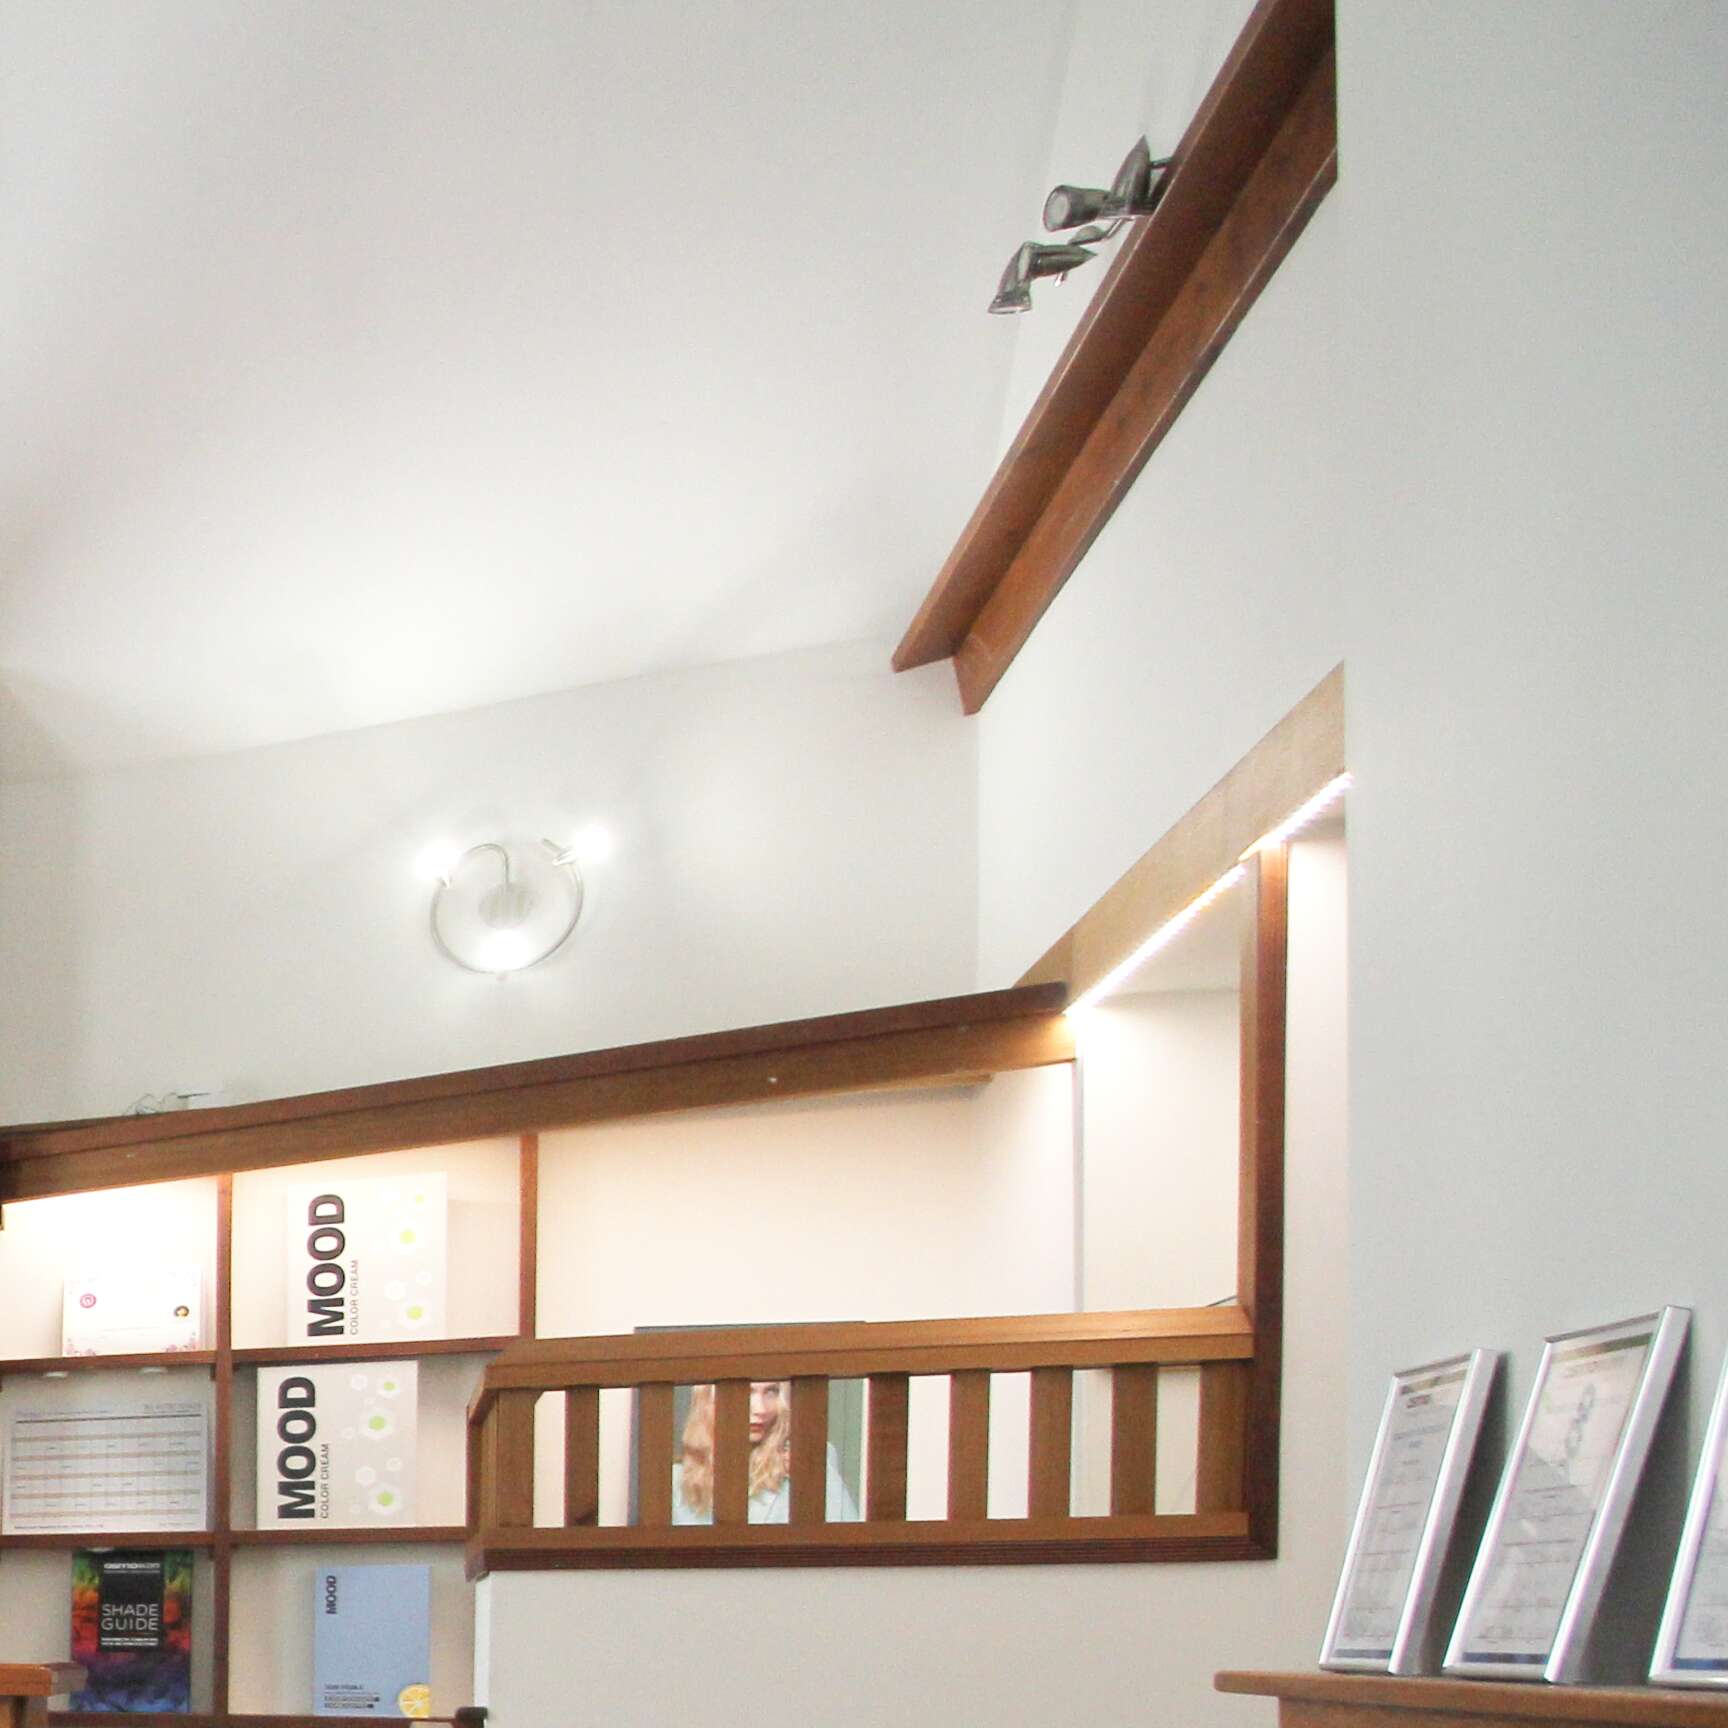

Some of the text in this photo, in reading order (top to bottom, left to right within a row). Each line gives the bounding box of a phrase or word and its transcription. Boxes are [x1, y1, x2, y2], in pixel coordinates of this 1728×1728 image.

[307, 1194, 345, 1337] MOOD
[349, 1259, 359, 1335] COLOR CREAM
[277, 1376, 317, 1519] MOOD
[320, 1443, 329, 1519] COLOR CREAM
[101, 1617, 159, 1631] GUIDE
[102, 1603, 159, 1617] SHADE
[325, 1575, 337, 1615] MOOD
